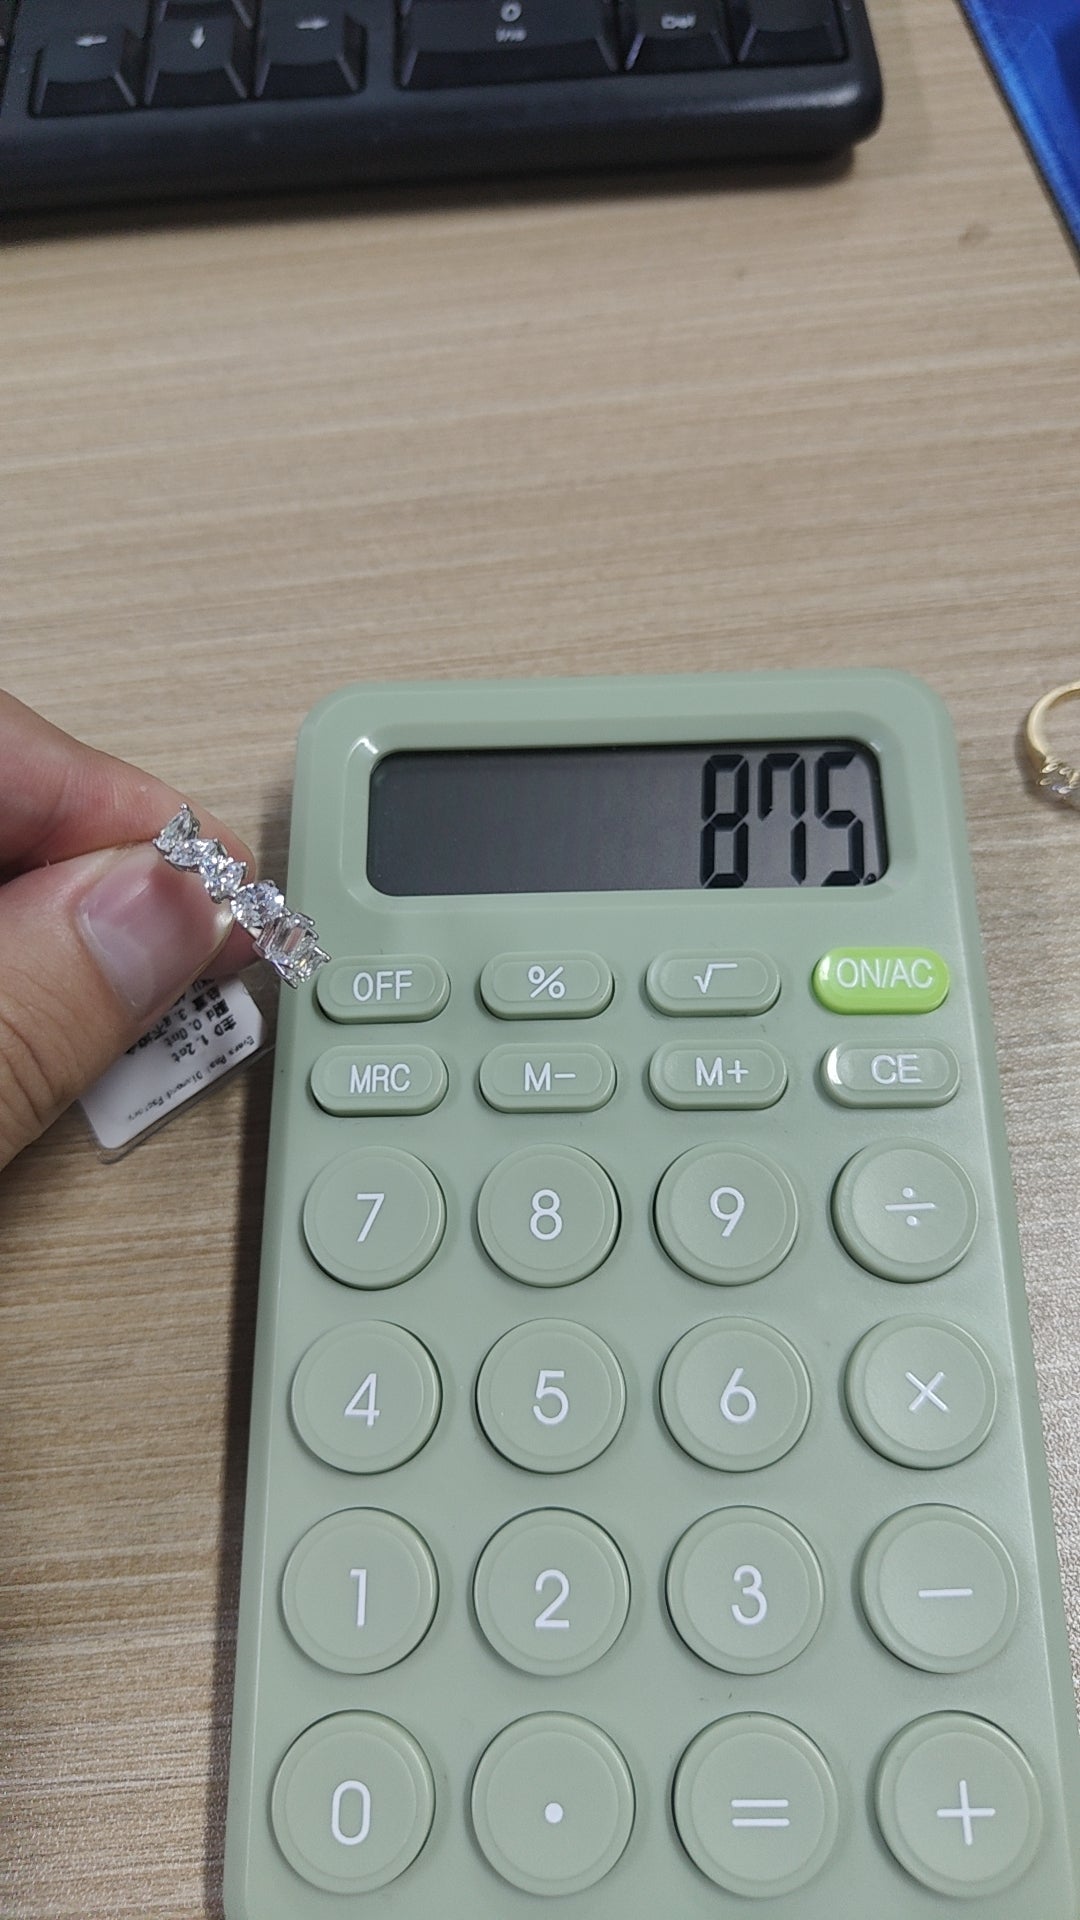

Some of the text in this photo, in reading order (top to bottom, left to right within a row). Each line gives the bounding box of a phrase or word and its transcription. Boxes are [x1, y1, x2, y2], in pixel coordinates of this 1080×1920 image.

[354, 970, 412, 1001] OFF
[834, 956, 934, 989] ON/AC
[212, 1014, 238, 1039] 主D
[351, 1064, 410, 1093] MRC
[697, 1057, 748, 1086] M+
[872, 1054, 922, 1084] CE
[357, 1194, 384, 1241] 7
[531, 1190, 562, 1240] 8
[711, 1187, 744, 1236] 9
[345, 1374, 379, 1426] 4
[534, 1371, 568, 1424] 5
[721, 1368, 756, 1423] 6
[351, 1569, 366, 1626] 1
[535, 1570, 569, 1628] 2
[732, 1565, 767, 1624] 3
[332, 1781, 370, 1845] 0
